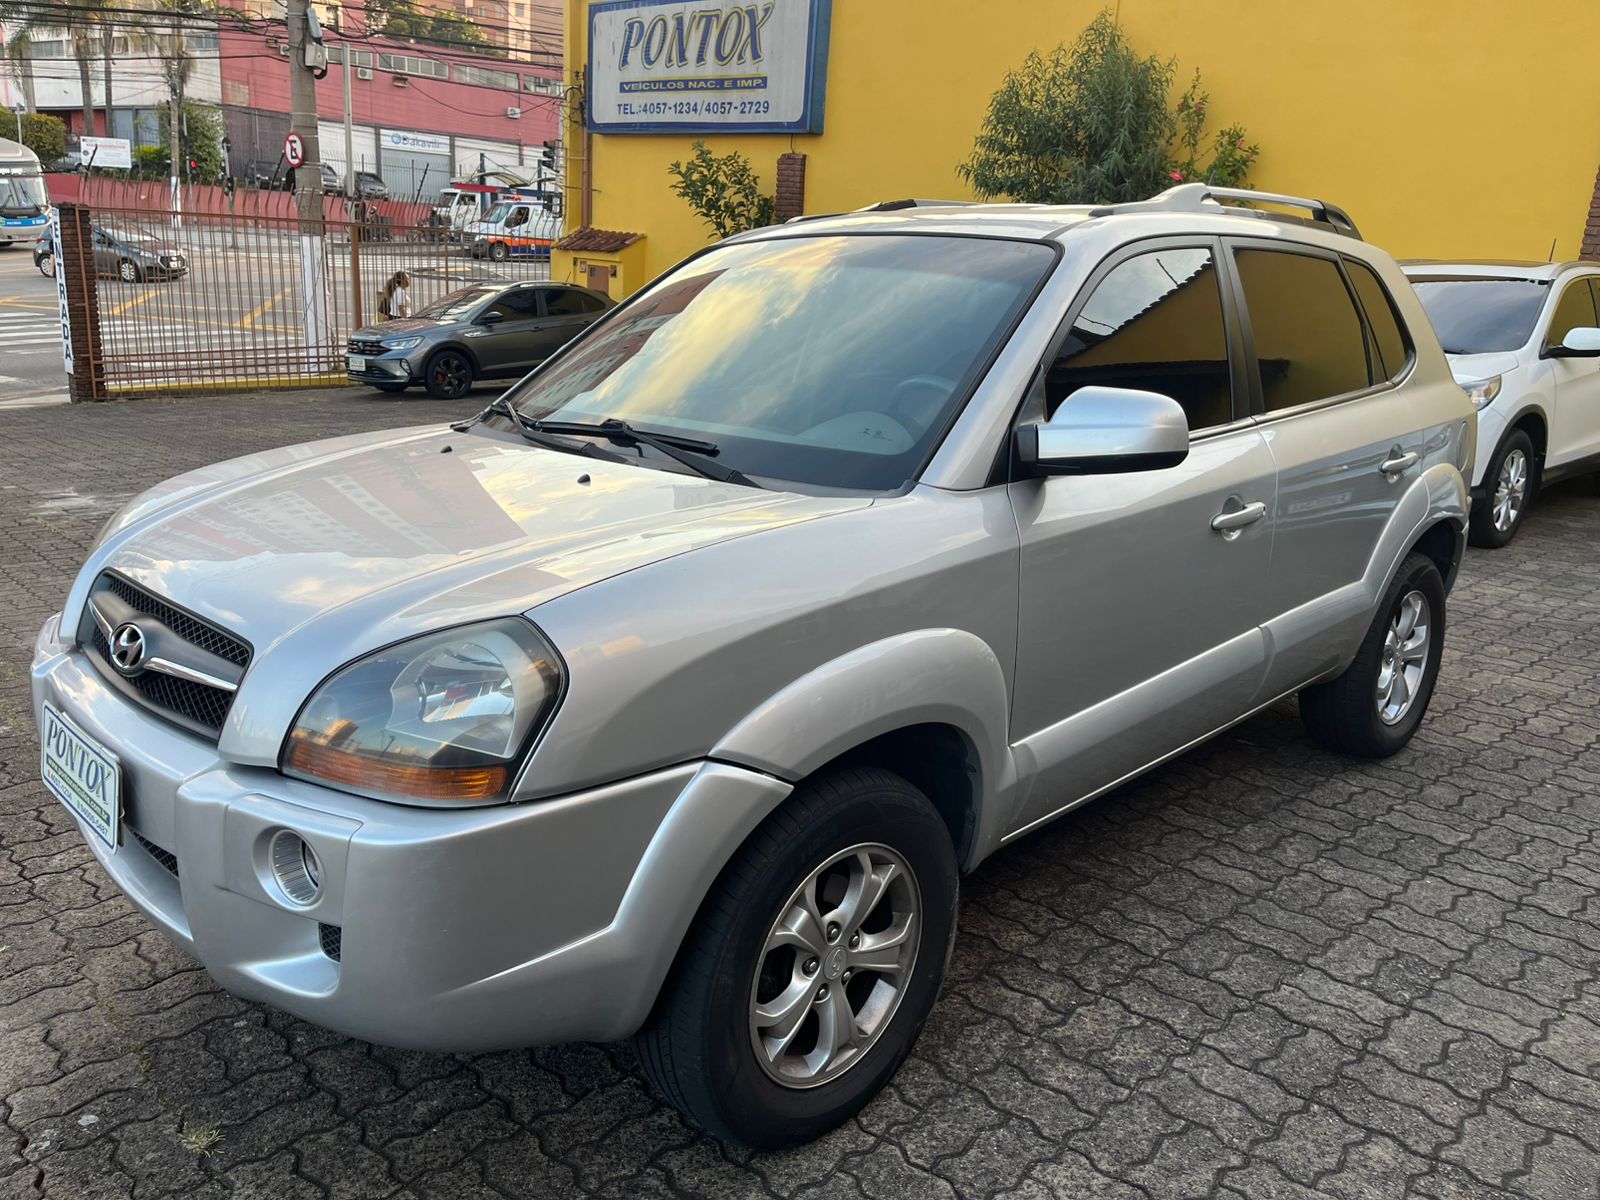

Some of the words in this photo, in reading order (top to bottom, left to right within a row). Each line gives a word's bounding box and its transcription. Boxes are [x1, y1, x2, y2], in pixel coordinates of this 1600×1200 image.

[619, 2, 774, 71] PONTOX
[688, 80, 720, 89] NAC.
[724, 80, 732, 88] E
[737, 78, 764, 87] IMP.
[53, 221, 72, 361] ENTRADA
[46, 717, 111, 804] PONTOX
